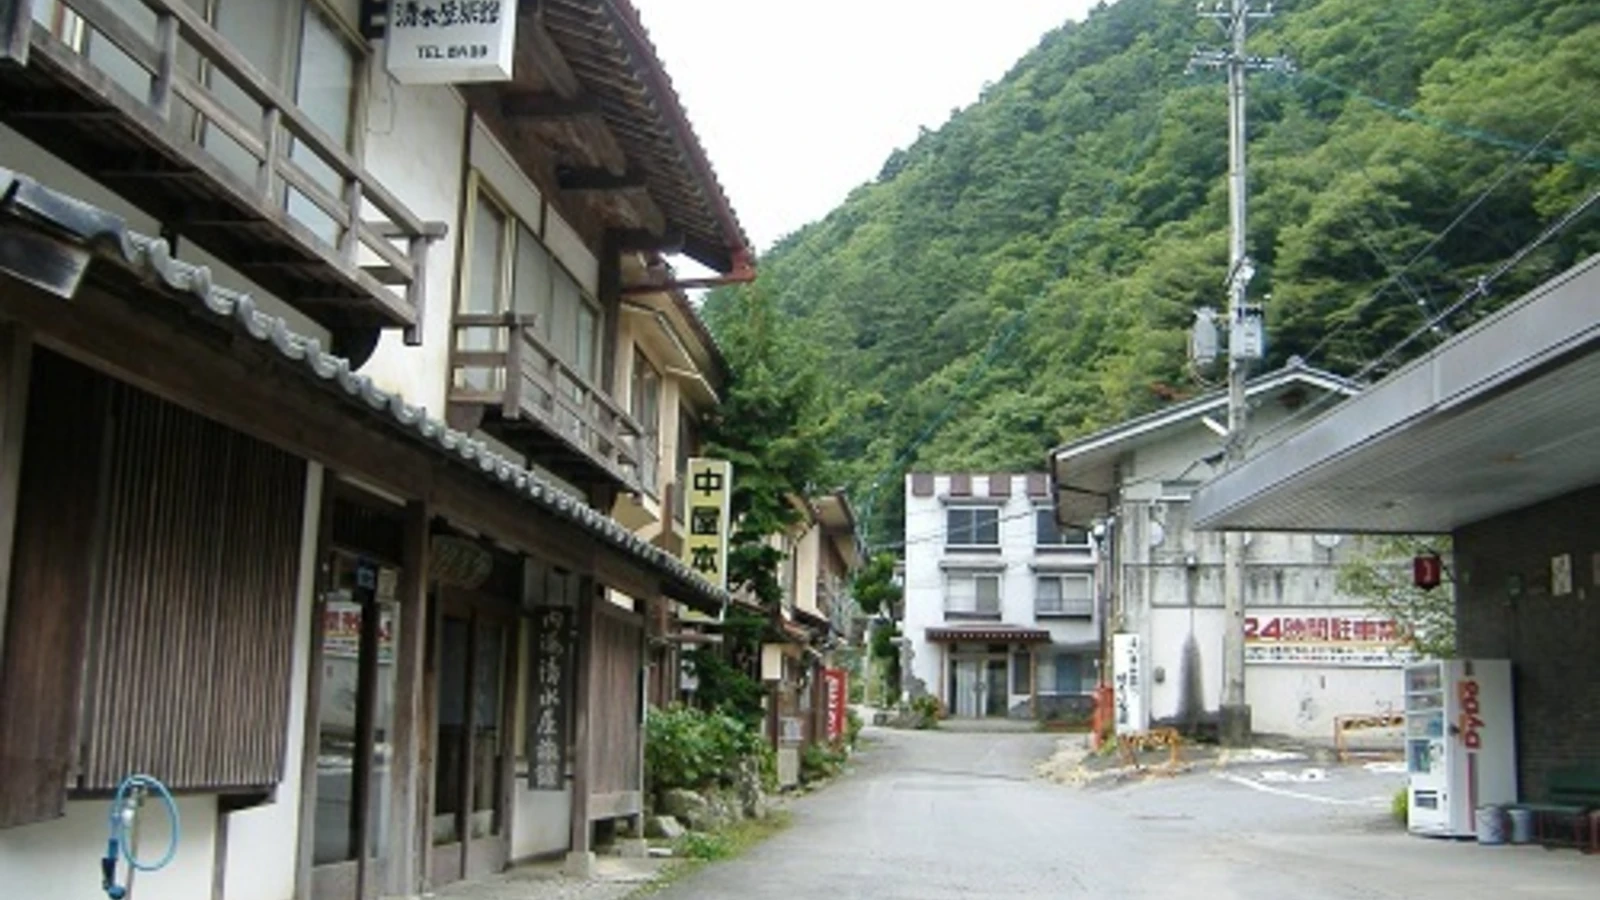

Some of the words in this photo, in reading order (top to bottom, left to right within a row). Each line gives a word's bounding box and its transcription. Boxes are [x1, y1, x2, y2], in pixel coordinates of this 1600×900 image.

[417, 45, 444, 58] TEL
[690, 467, 723, 575] 中屋本
[1243, 616, 1413, 642] 24時間駐車禁
